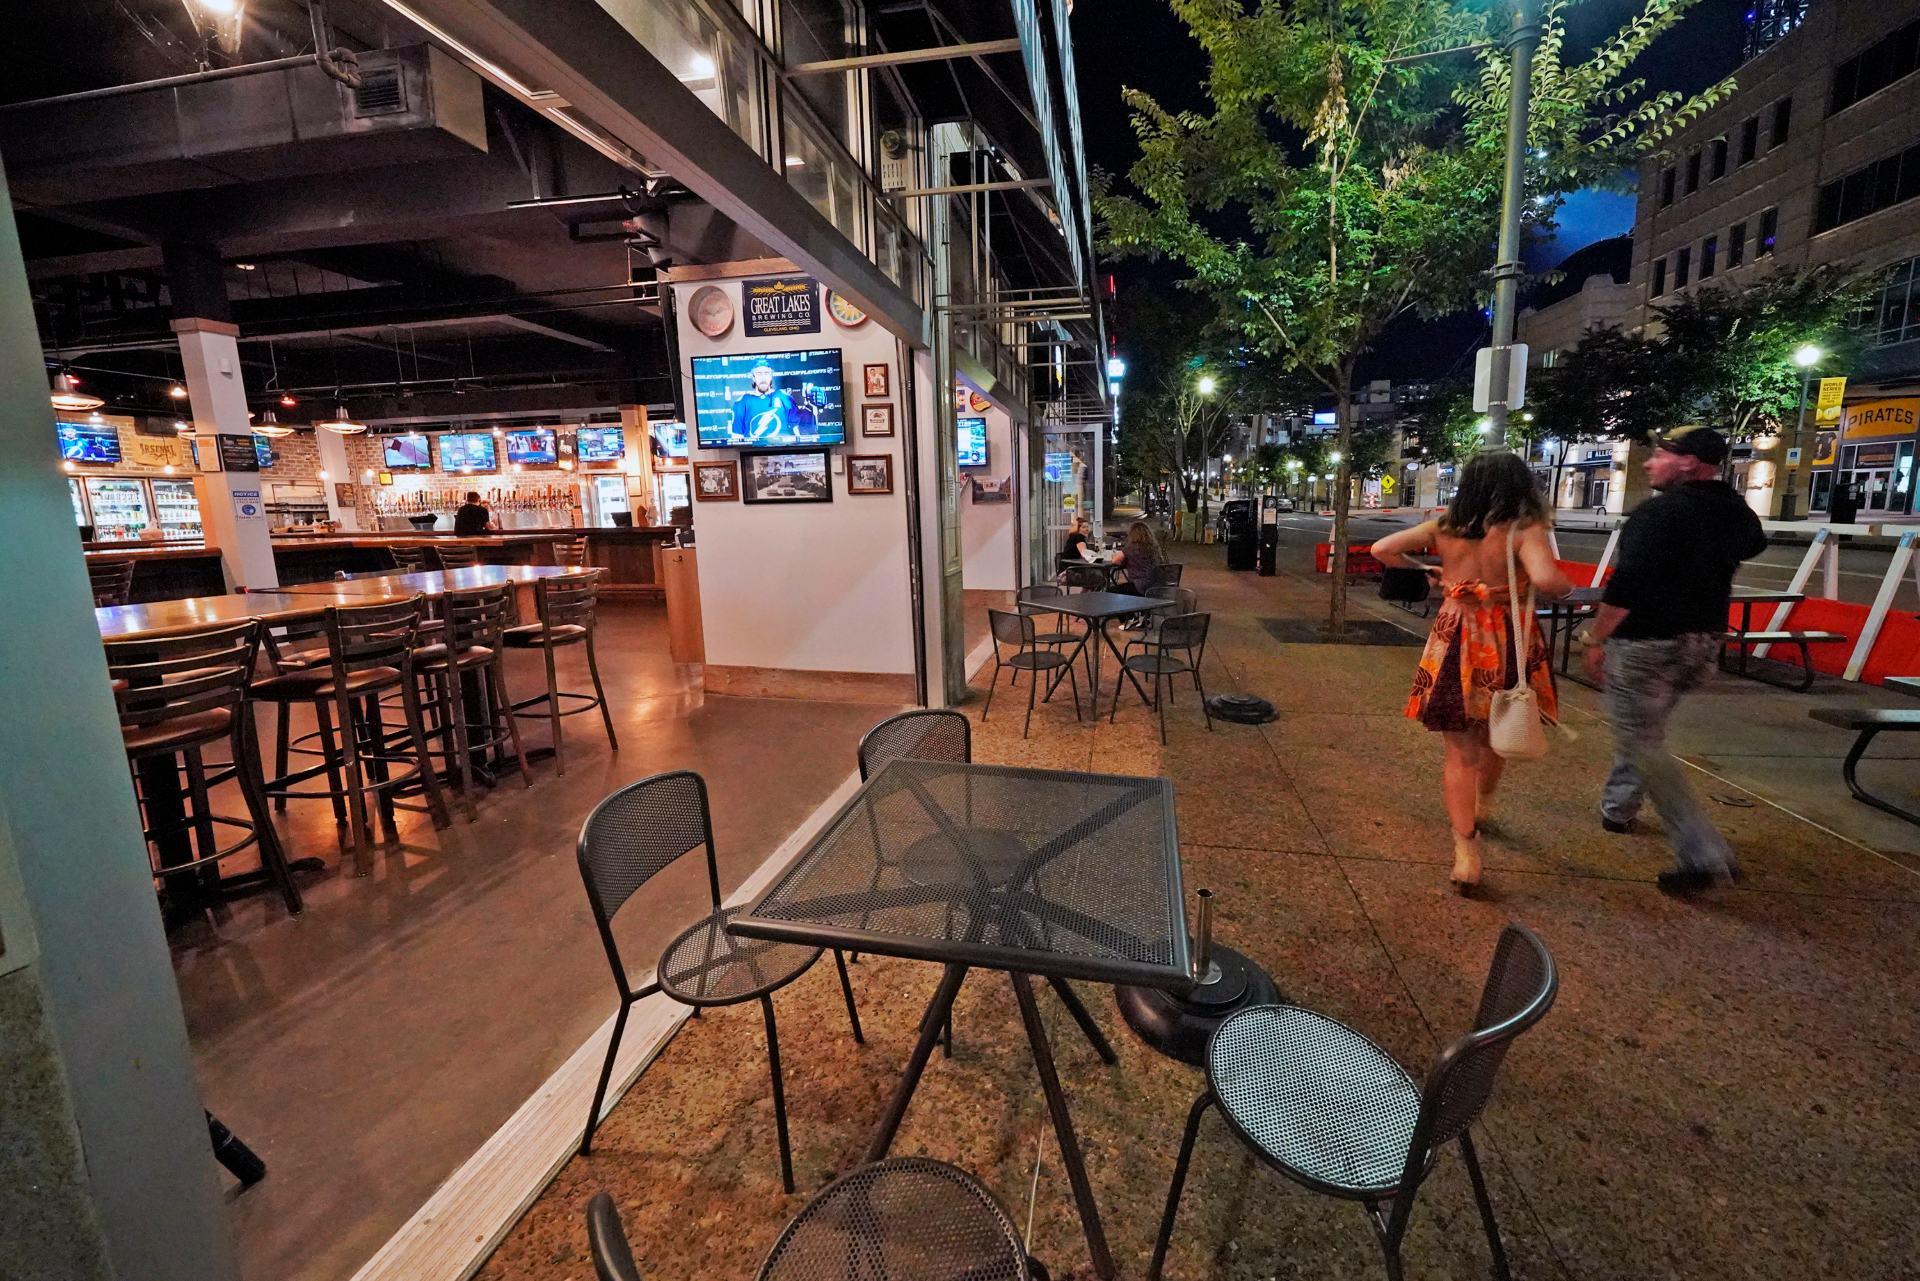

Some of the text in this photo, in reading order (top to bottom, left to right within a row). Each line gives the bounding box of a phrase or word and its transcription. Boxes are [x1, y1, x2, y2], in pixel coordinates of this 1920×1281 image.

[750, 294, 811, 315] GREAT LAKES
[752, 313, 793, 321] BREWING
[1846, 407, 1914, 432] PIRATES
[139, 443, 177, 457] ARSENAL
